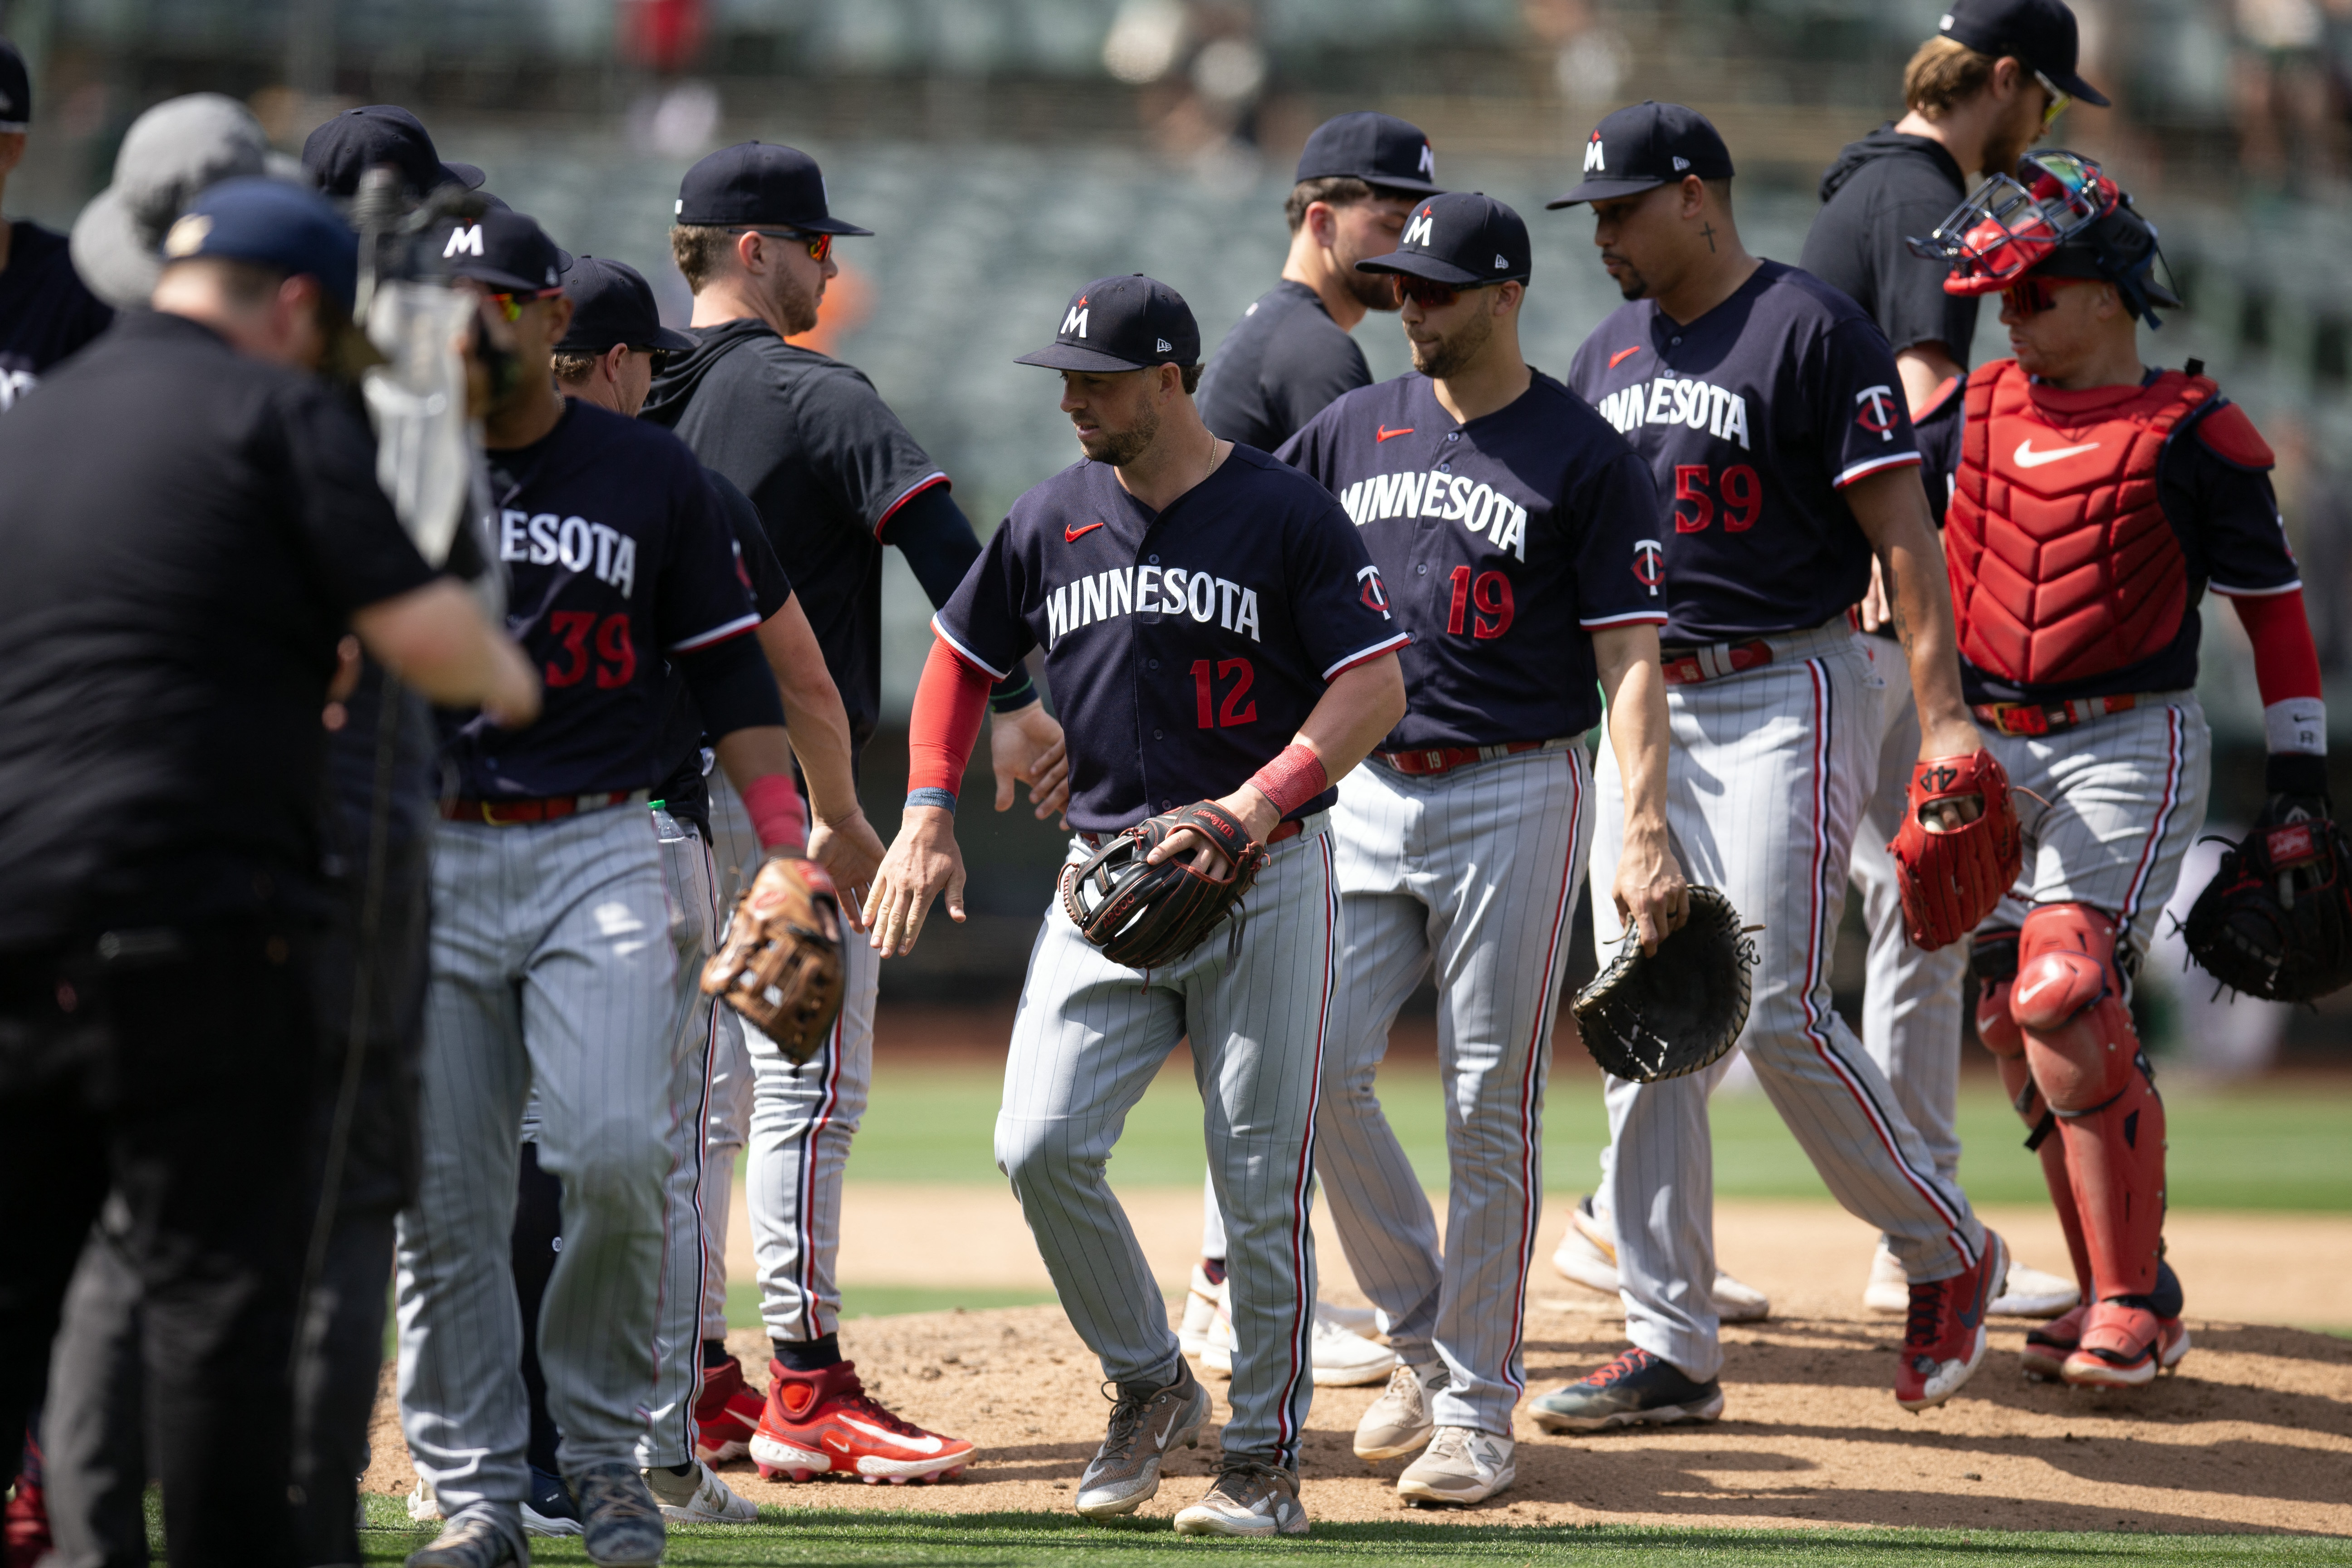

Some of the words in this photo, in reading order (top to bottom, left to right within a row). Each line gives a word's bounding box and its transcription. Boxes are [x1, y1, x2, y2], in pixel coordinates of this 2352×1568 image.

[1583, 141, 1605, 172] M
[442, 225, 485, 258] M
[1403, 216, 1433, 246] M
[1060, 306, 1089, 338] M
[1595, 378, 1750, 451] INNESOTA
[1341, 470, 1527, 563] MINNESOTA
[1675, 464, 1763, 534] 59
[500, 509, 637, 601] ESOTA
[1046, 565, 1260, 650] MINNESOTA
[1447, 565, 1515, 640] 19
[545, 610, 637, 689] 39
[1189, 657, 1257, 729] 12
[1426, 750, 1441, 769] 19
[1192, 809, 1235, 840] Wilson
[1102, 893, 1136, 929] A2000
